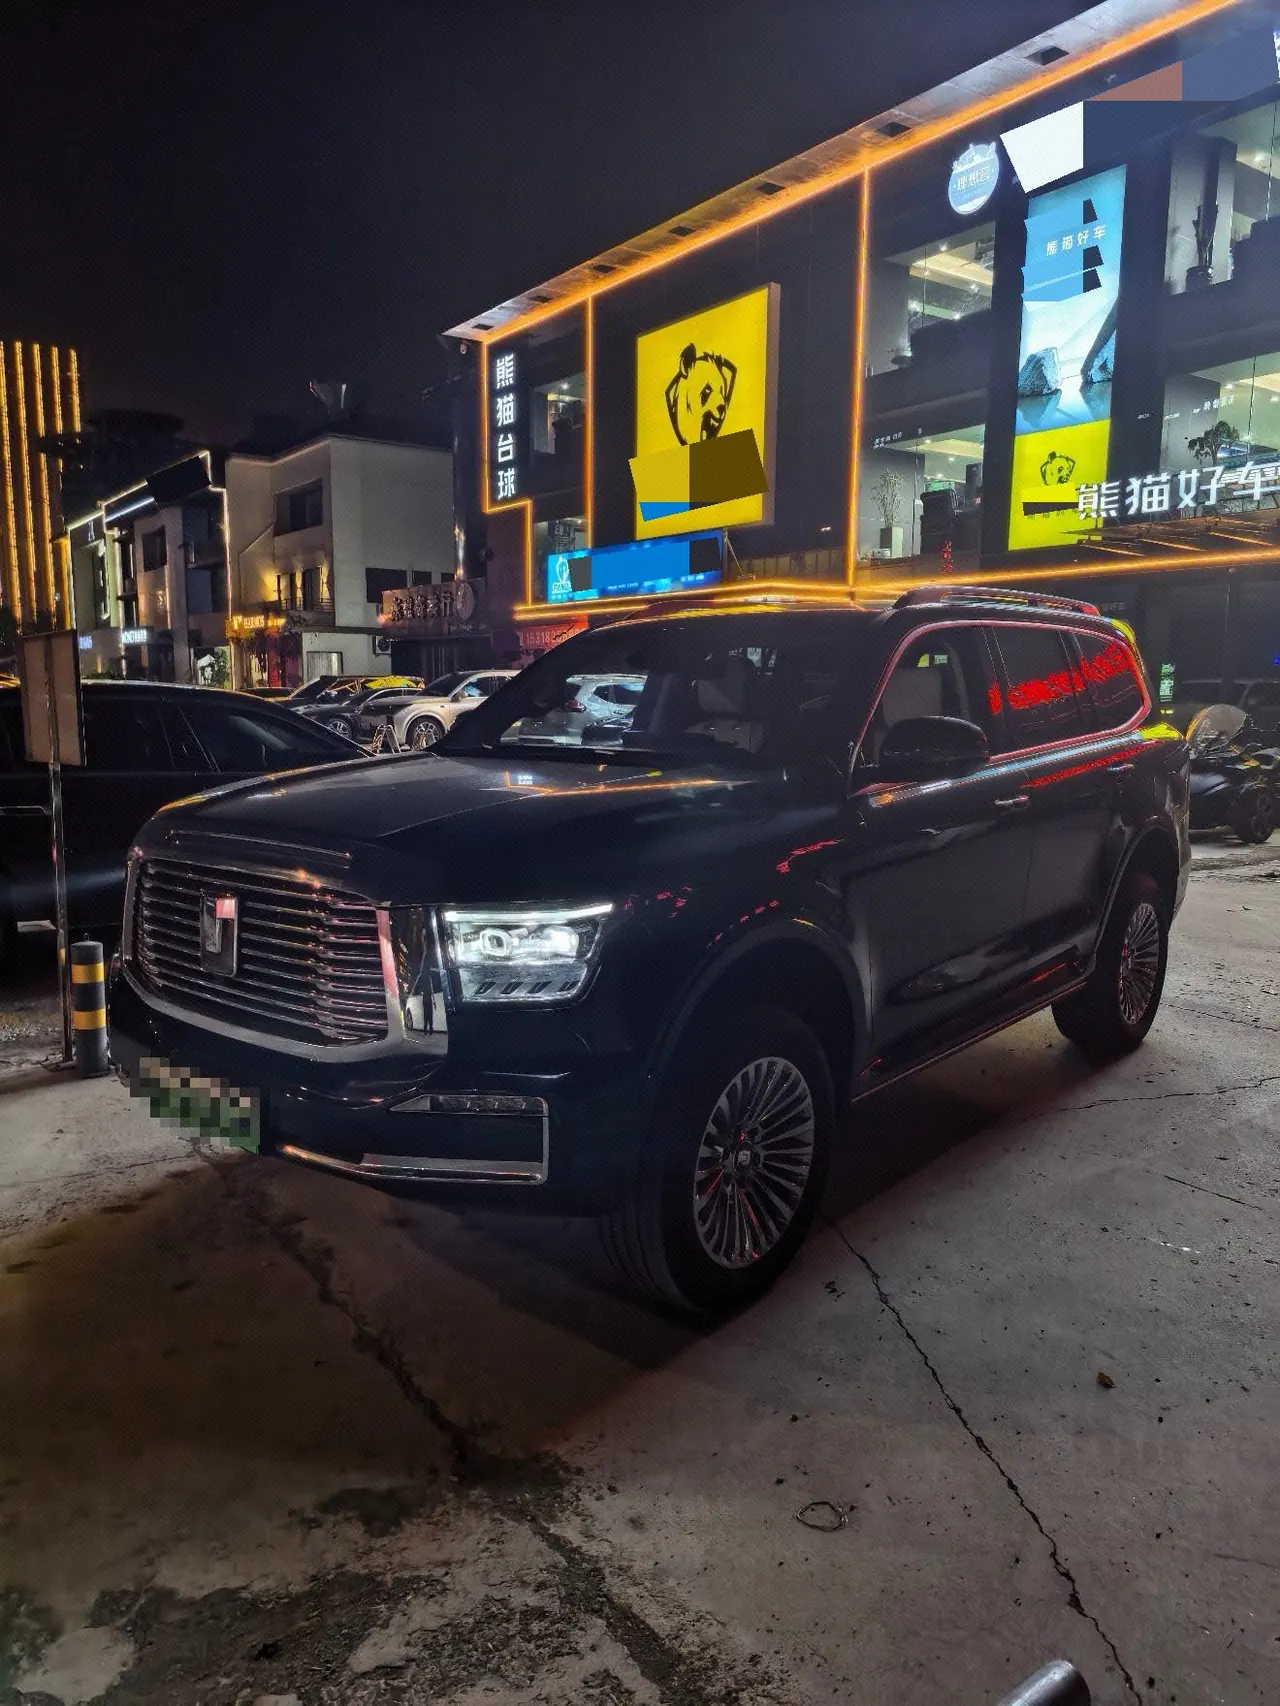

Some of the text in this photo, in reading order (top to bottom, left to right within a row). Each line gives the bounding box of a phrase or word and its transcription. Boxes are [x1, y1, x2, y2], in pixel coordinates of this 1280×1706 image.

[496, 352, 515, 500] 熊猫台球
[1077, 461, 1280, 520] 熊猫好车
